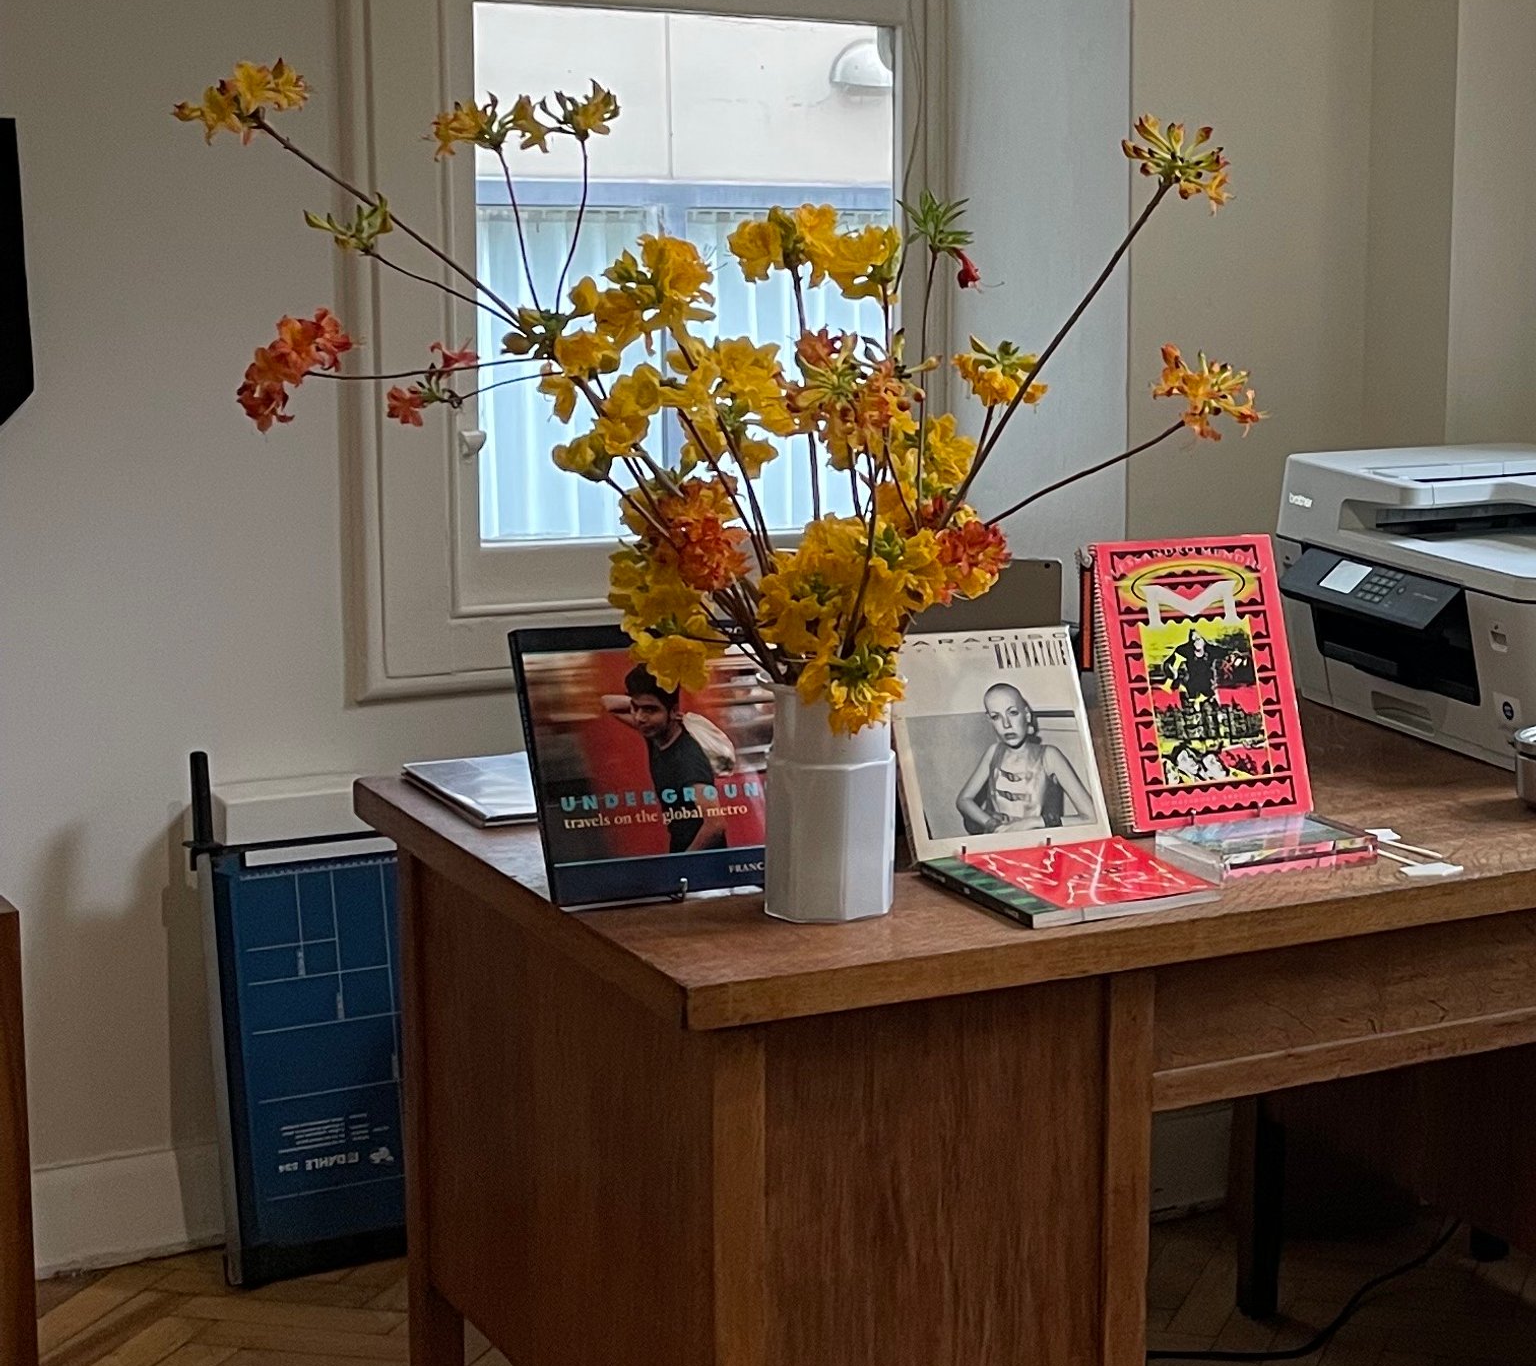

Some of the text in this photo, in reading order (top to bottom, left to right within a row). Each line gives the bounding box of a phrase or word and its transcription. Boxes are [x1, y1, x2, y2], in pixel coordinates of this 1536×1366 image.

[901, 632, 1067, 647] ARADISO
[563, 803, 748, 830] travels on the global metro
[305, 1153, 347, 1172] DAHLE
